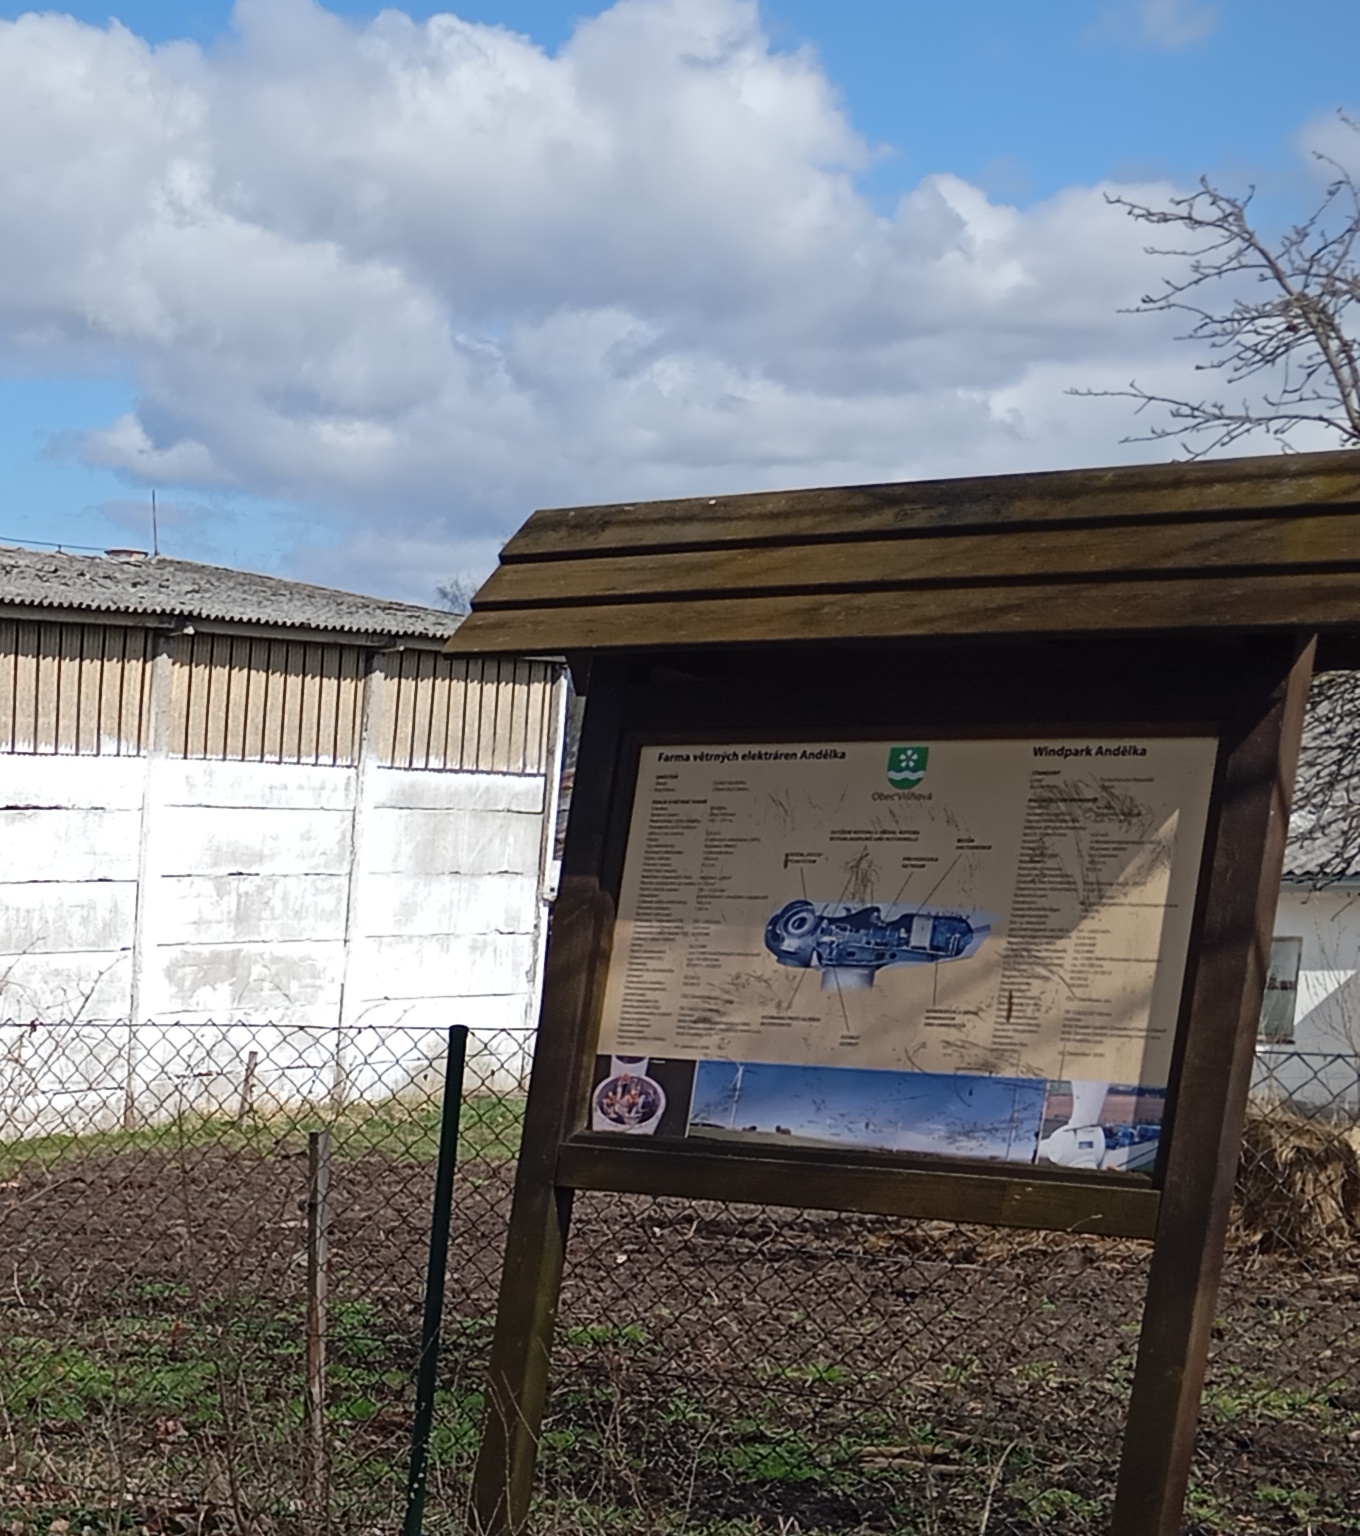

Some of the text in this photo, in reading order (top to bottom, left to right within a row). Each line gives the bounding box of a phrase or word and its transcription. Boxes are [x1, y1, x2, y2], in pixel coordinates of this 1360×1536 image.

[657, 749, 847, 764] Farma větrných elektráren Andělka
[1033, 745, 1147, 759] Windpark Andělka
[871, 791, 895, 801] Obec
